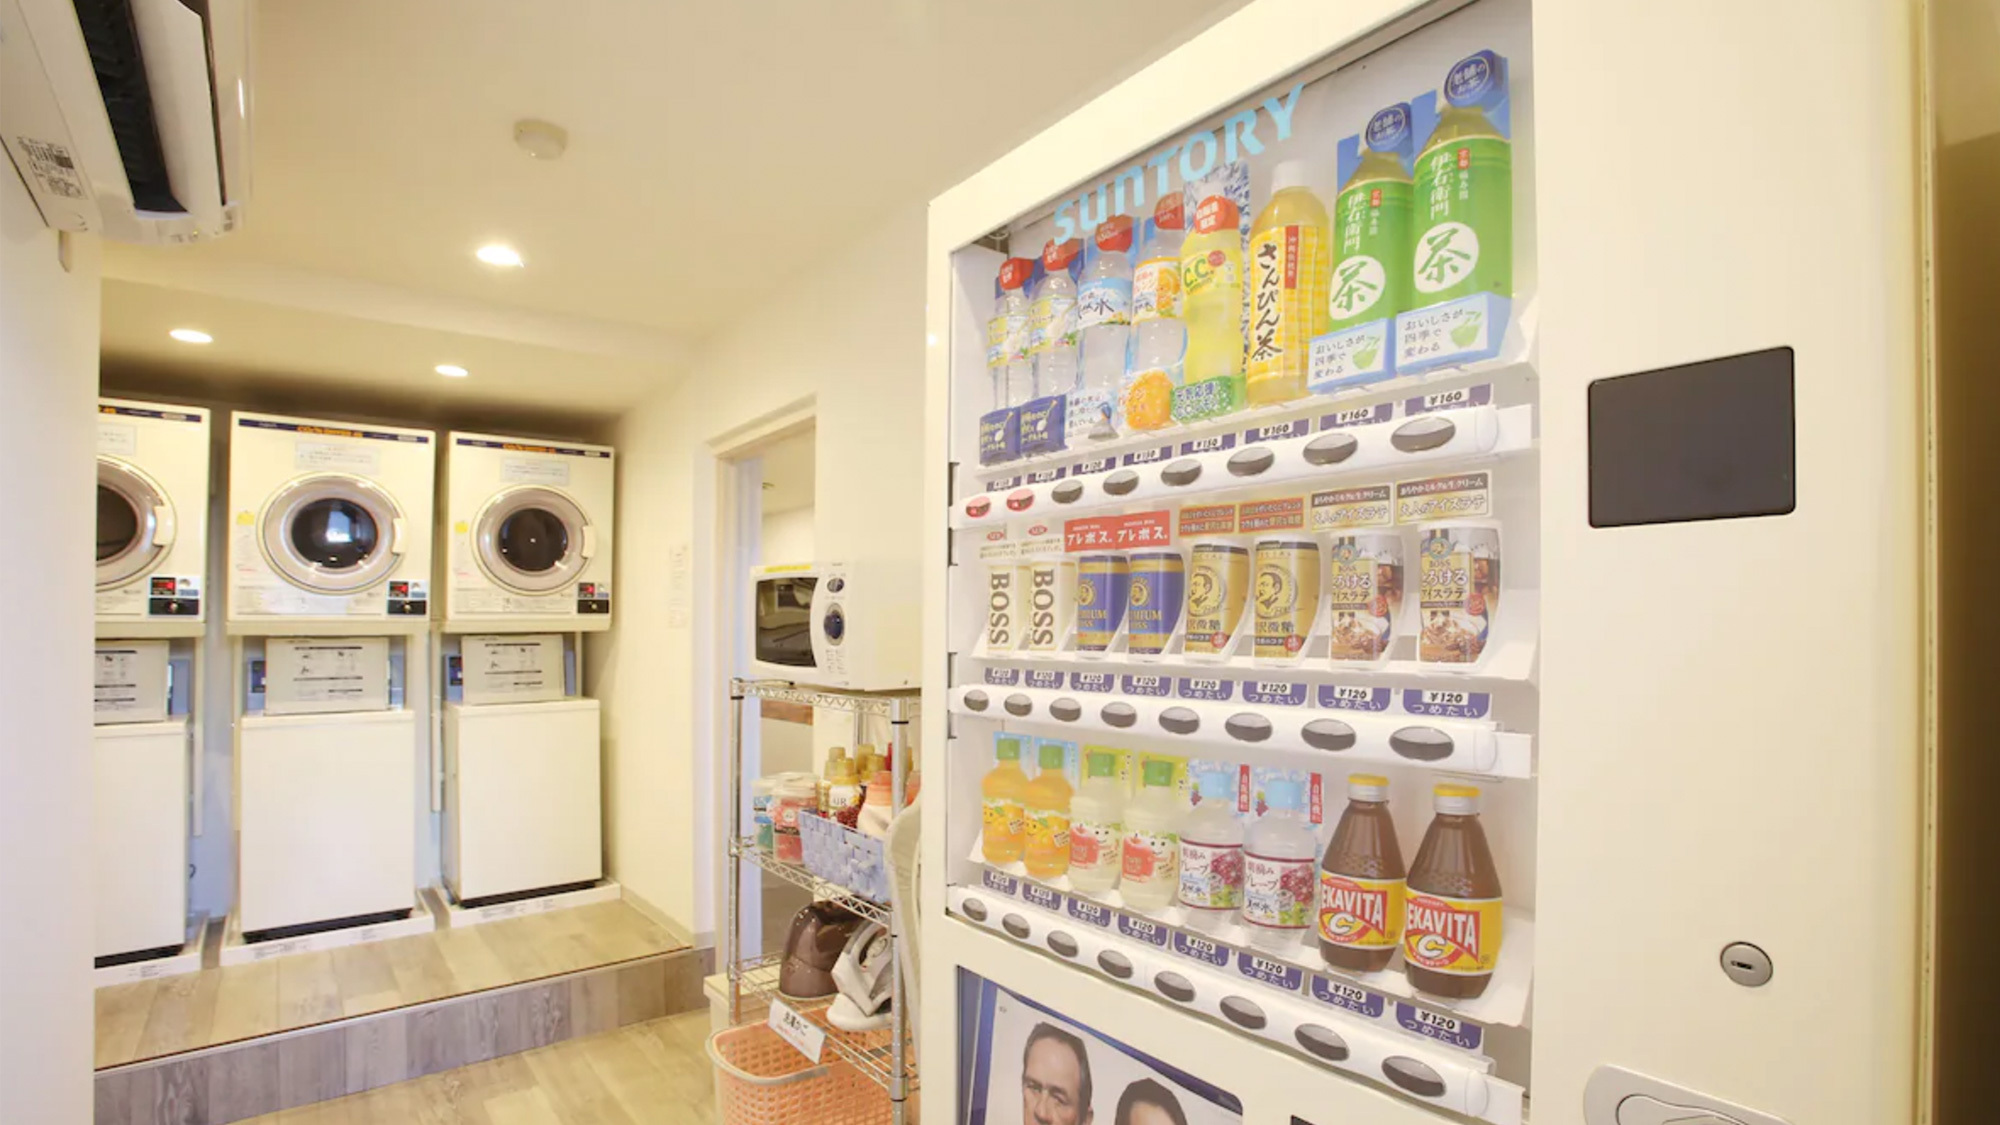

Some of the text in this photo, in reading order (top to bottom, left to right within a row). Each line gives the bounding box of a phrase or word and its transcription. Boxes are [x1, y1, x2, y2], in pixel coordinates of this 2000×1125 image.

[1417, 228, 1471, 284] 茶
[1332, 260, 1378, 312] 茶
[1252, 243, 1283, 362] さんぴん茶
[1404, 308, 1464, 331] おいしさが
[1430, 391, 1462, 405] ¥160
[1341, 409, 1369, 421] ¥160
[989, 573, 1010, 645] BOSS
[1032, 569, 1055, 645] BOSS
[1083, 674, 1102, 683] ¥120
[1136, 676, 1157, 686] ¥120
[1194, 679, 1217, 690] ¥120
[1126, 686, 1166, 696] つめたい
[1183, 689, 1226, 700] つめたい
[1261, 683, 1287, 694] ¥120
[1339, 687, 1367, 700] ¥120
[1249, 694, 1300, 705] つめたい
[1325, 699, 1382, 711] つめたい
[1430, 691, 1463, 704] ¥120
[1412, 703, 1478, 717] つめたい
[1133, 919, 1153, 933] ¥120
[1329, 911, 1357, 936] C
[1122, 926, 1163, 945] つめたい
[1190, 937, 1213, 951] ¥120
[1418, 933, 1448, 959] C
[1180, 945, 1223, 966] つめたい
[1256, 958, 1283, 975] ¥120
[1244, 967, 1295, 989] つめたい
[1332, 982, 1363, 1000] ¥120
[1319, 991, 1377, 1016] つめたい
[1420, 1011, 1455, 1030] ¥120
[1404, 1019, 1471, 1048] つめたい
